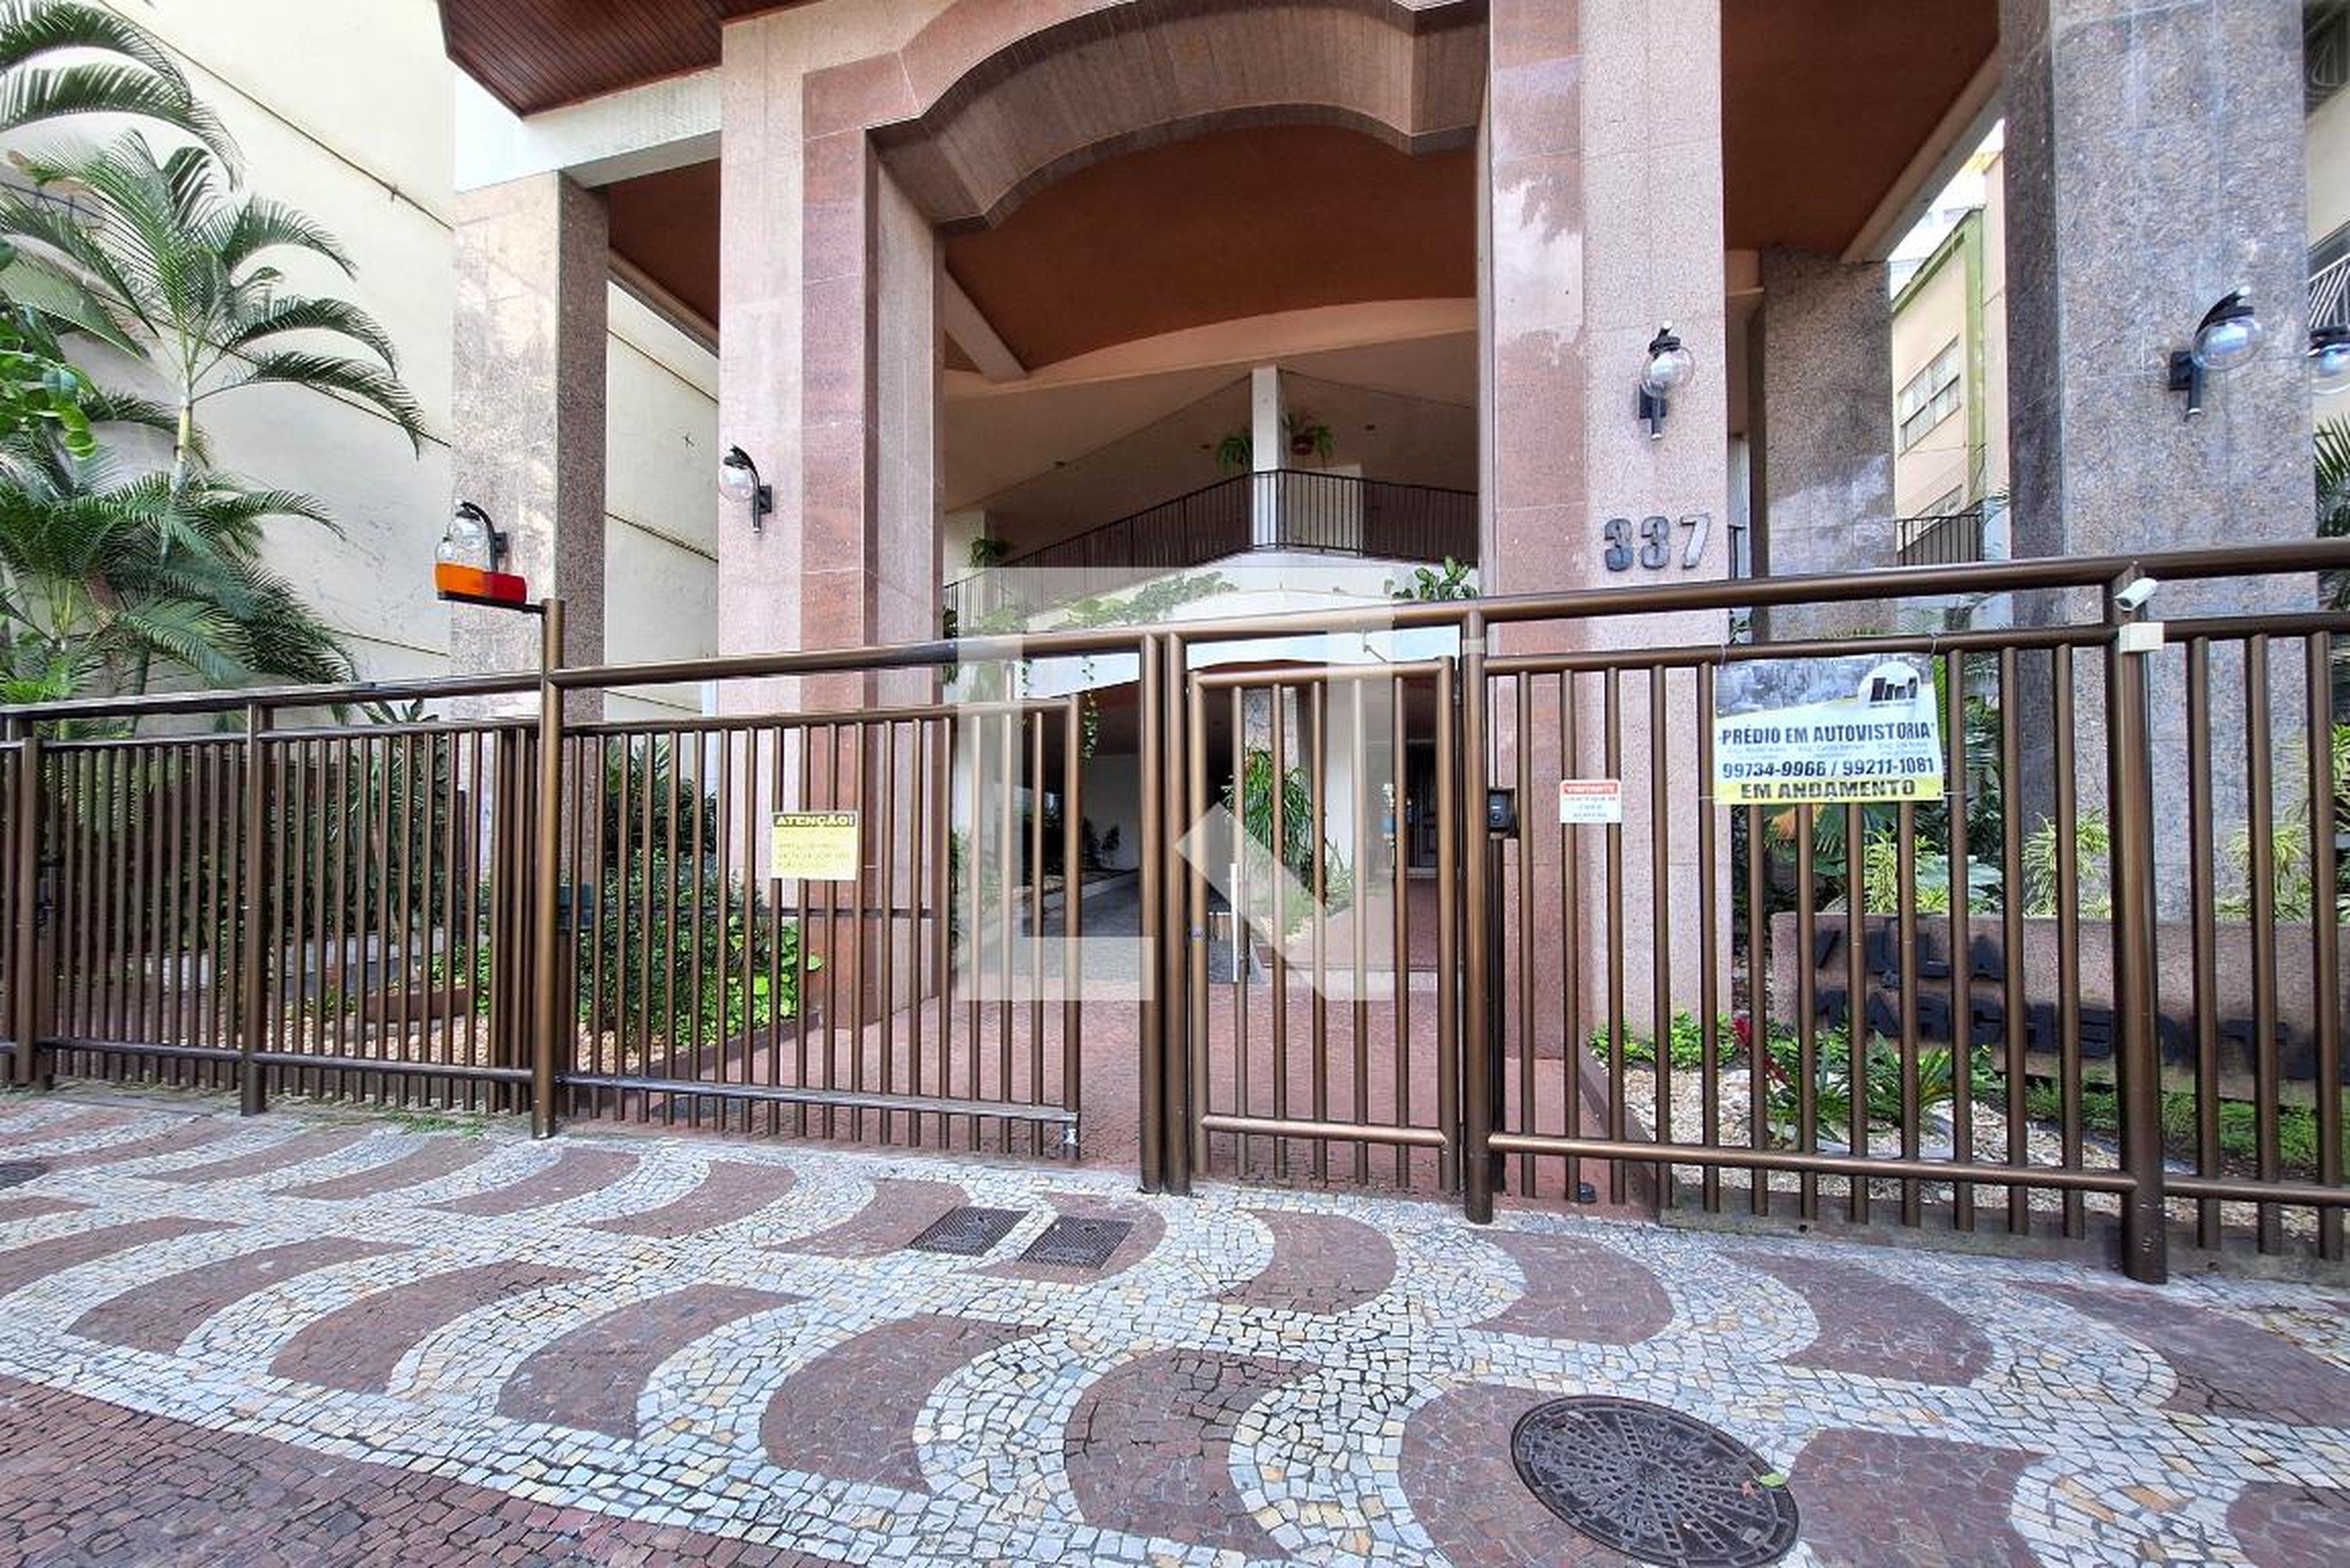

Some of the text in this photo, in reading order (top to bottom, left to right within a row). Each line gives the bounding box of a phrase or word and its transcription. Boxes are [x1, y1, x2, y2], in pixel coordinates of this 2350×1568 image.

[1604, 513, 1710, 572] 337
[1785, 726, 1808, 744] EM
[1813, 722, 1930, 742] AUTOVISTORIA
[1723, 761, 1826, 778] 99734-9966
[1843, 757, 1934, 777] 99211-1081
[1741, 780, 1915, 799] EM ANDAMENTO
[777, 815, 854, 827] ATENÇÃO!
